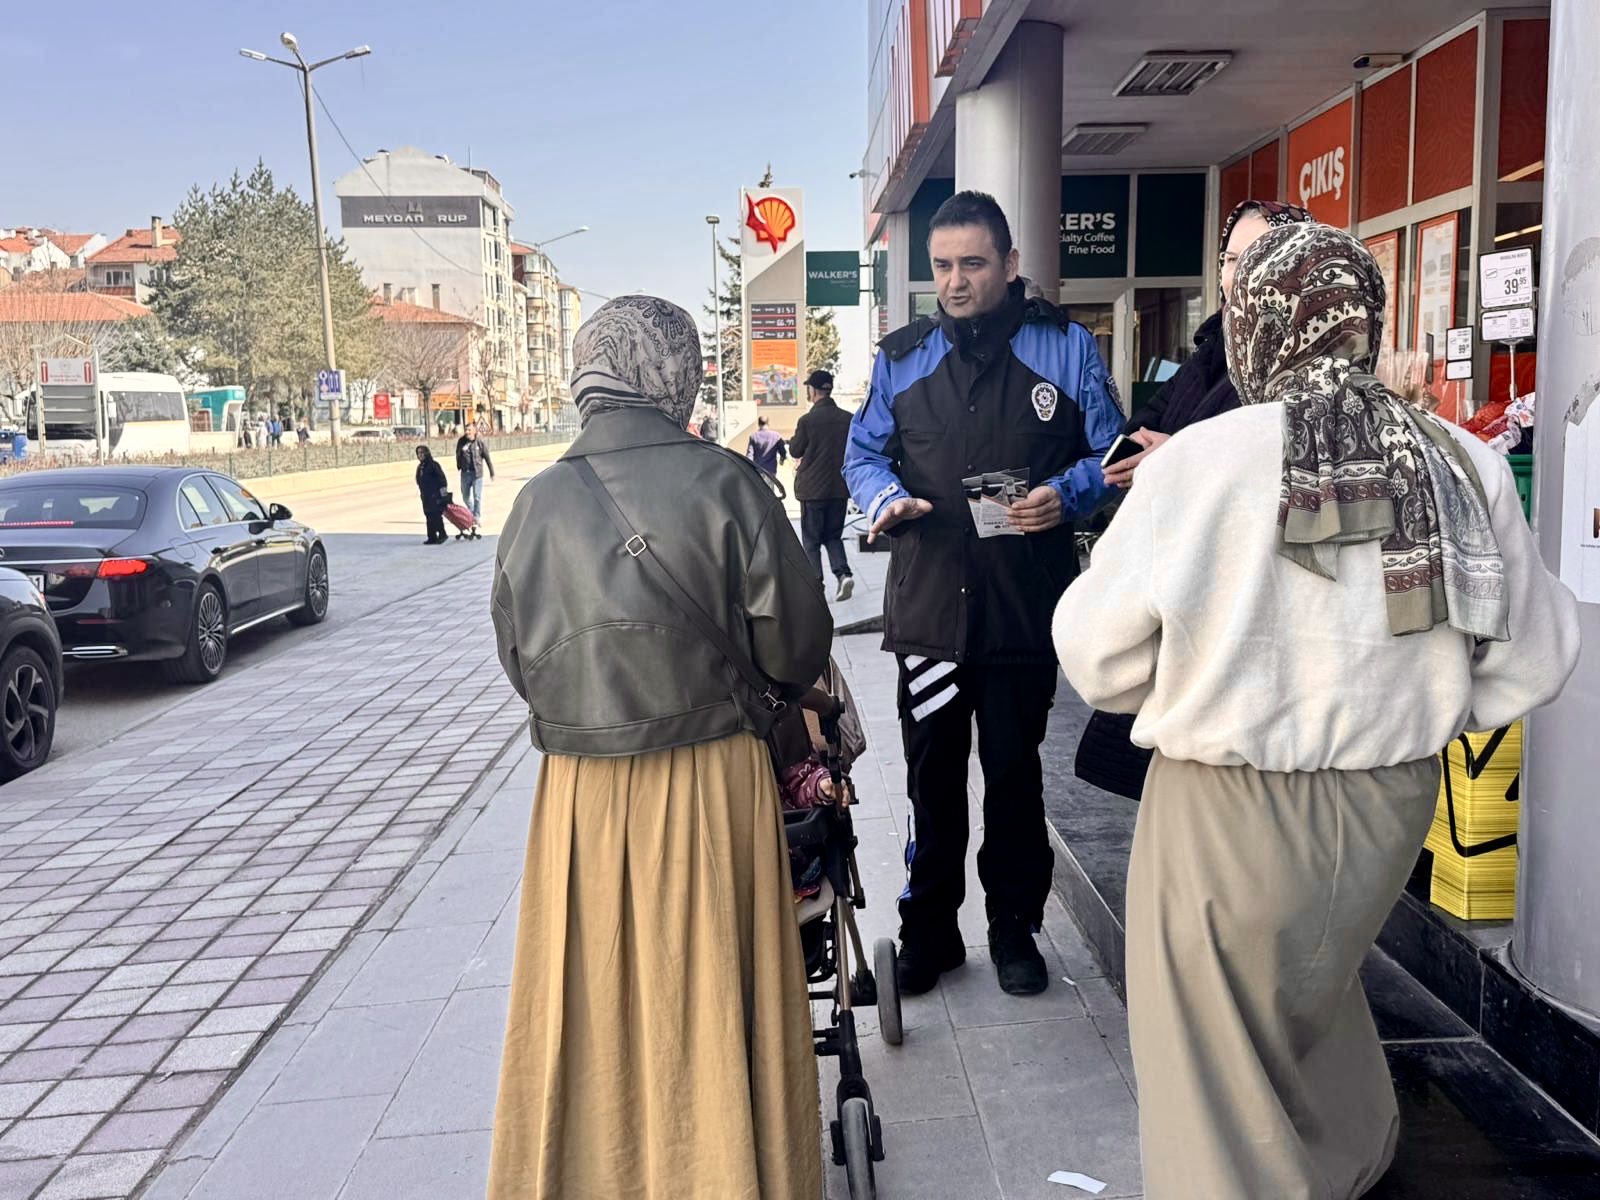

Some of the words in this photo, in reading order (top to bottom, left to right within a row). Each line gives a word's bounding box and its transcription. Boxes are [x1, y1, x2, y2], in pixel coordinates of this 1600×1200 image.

[1299, 146, 1345, 209] ÇIKIŞ
[1084, 232, 1116, 242] Coffee
[1069, 245, 1089, 254] Fine
[1090, 244, 1116, 254] Food
[808, 270, 858, 280] WALKER'S
